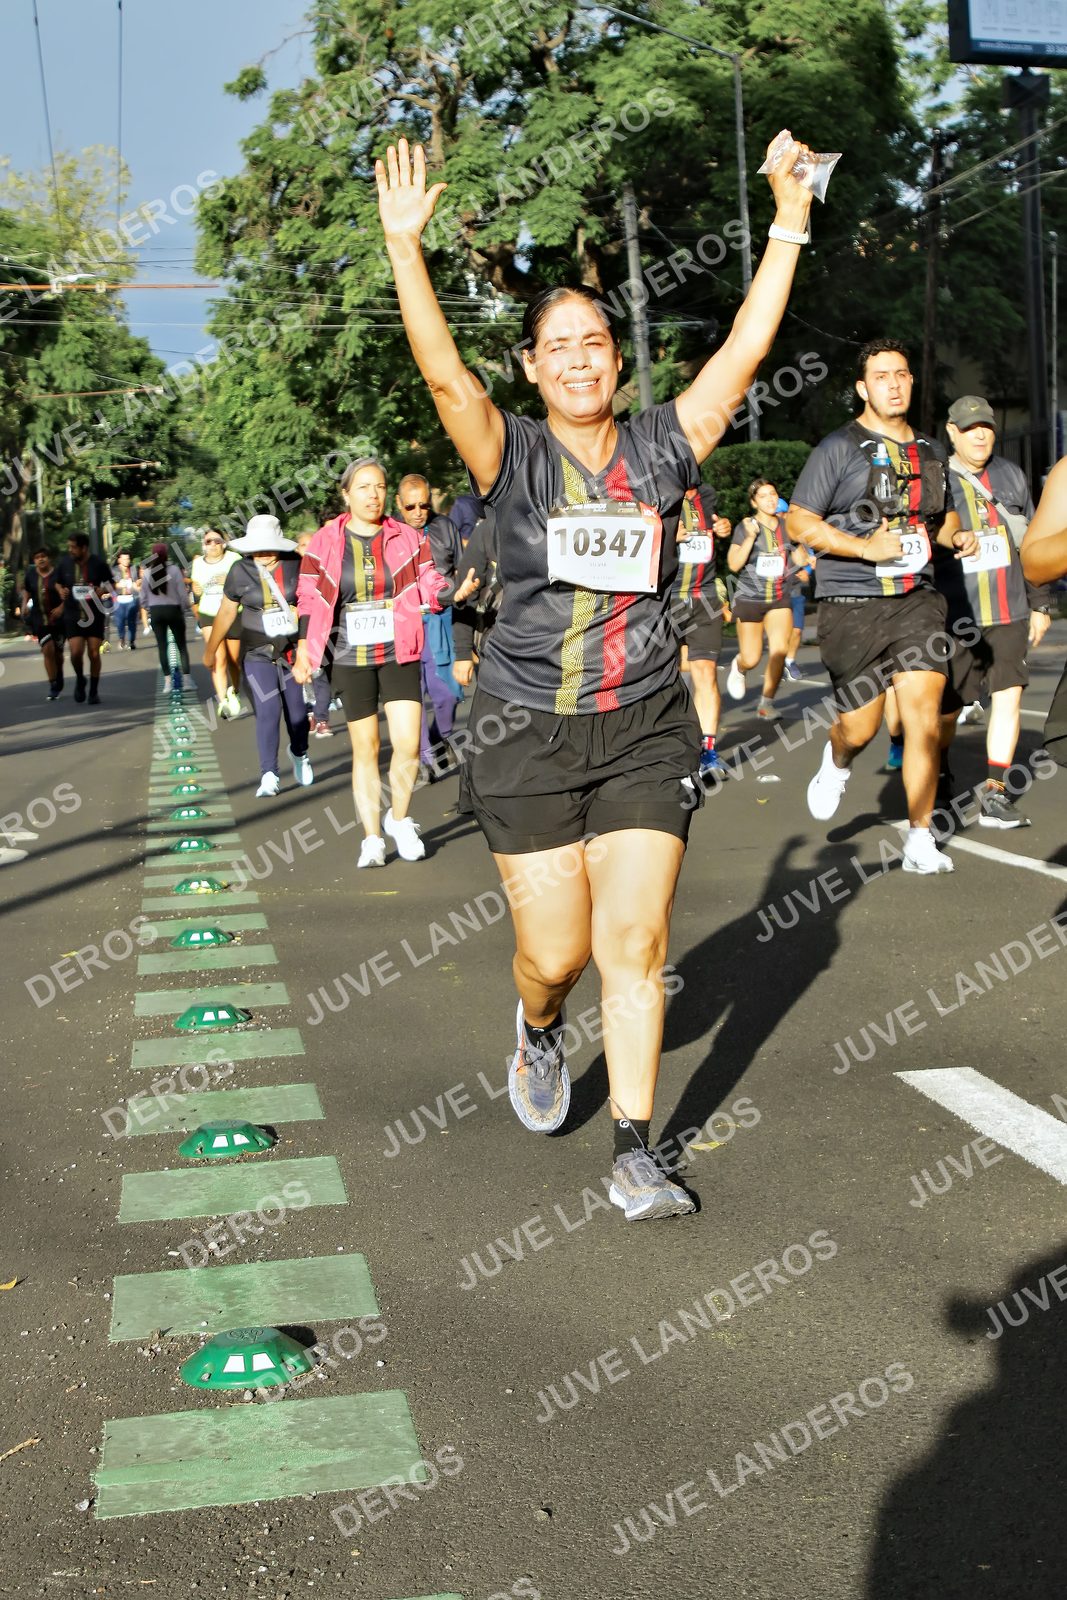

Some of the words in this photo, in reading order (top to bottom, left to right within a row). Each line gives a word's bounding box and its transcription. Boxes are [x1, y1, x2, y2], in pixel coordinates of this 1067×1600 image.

[554, 528, 656, 558] 10347
[685, 540, 707, 551] 9431
[354, 615, 386, 630] 6774
